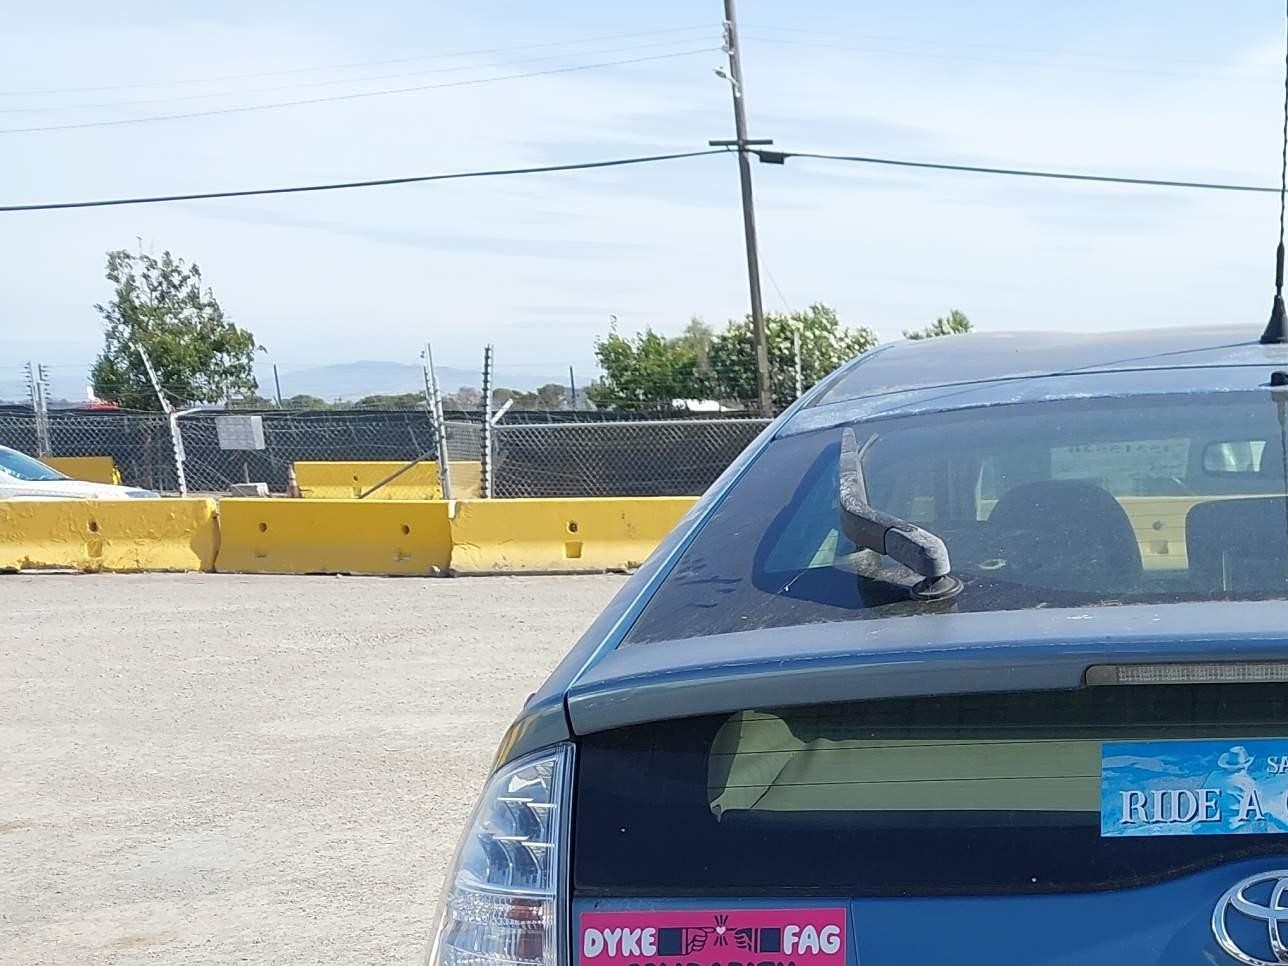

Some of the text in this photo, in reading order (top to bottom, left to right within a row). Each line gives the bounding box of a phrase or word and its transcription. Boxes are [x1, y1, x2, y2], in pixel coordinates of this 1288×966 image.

[1119, 788, 1222, 825] RIDE
[1238, 788, 1266, 822] A
[583, 925, 841, 958] DYKE FAG
